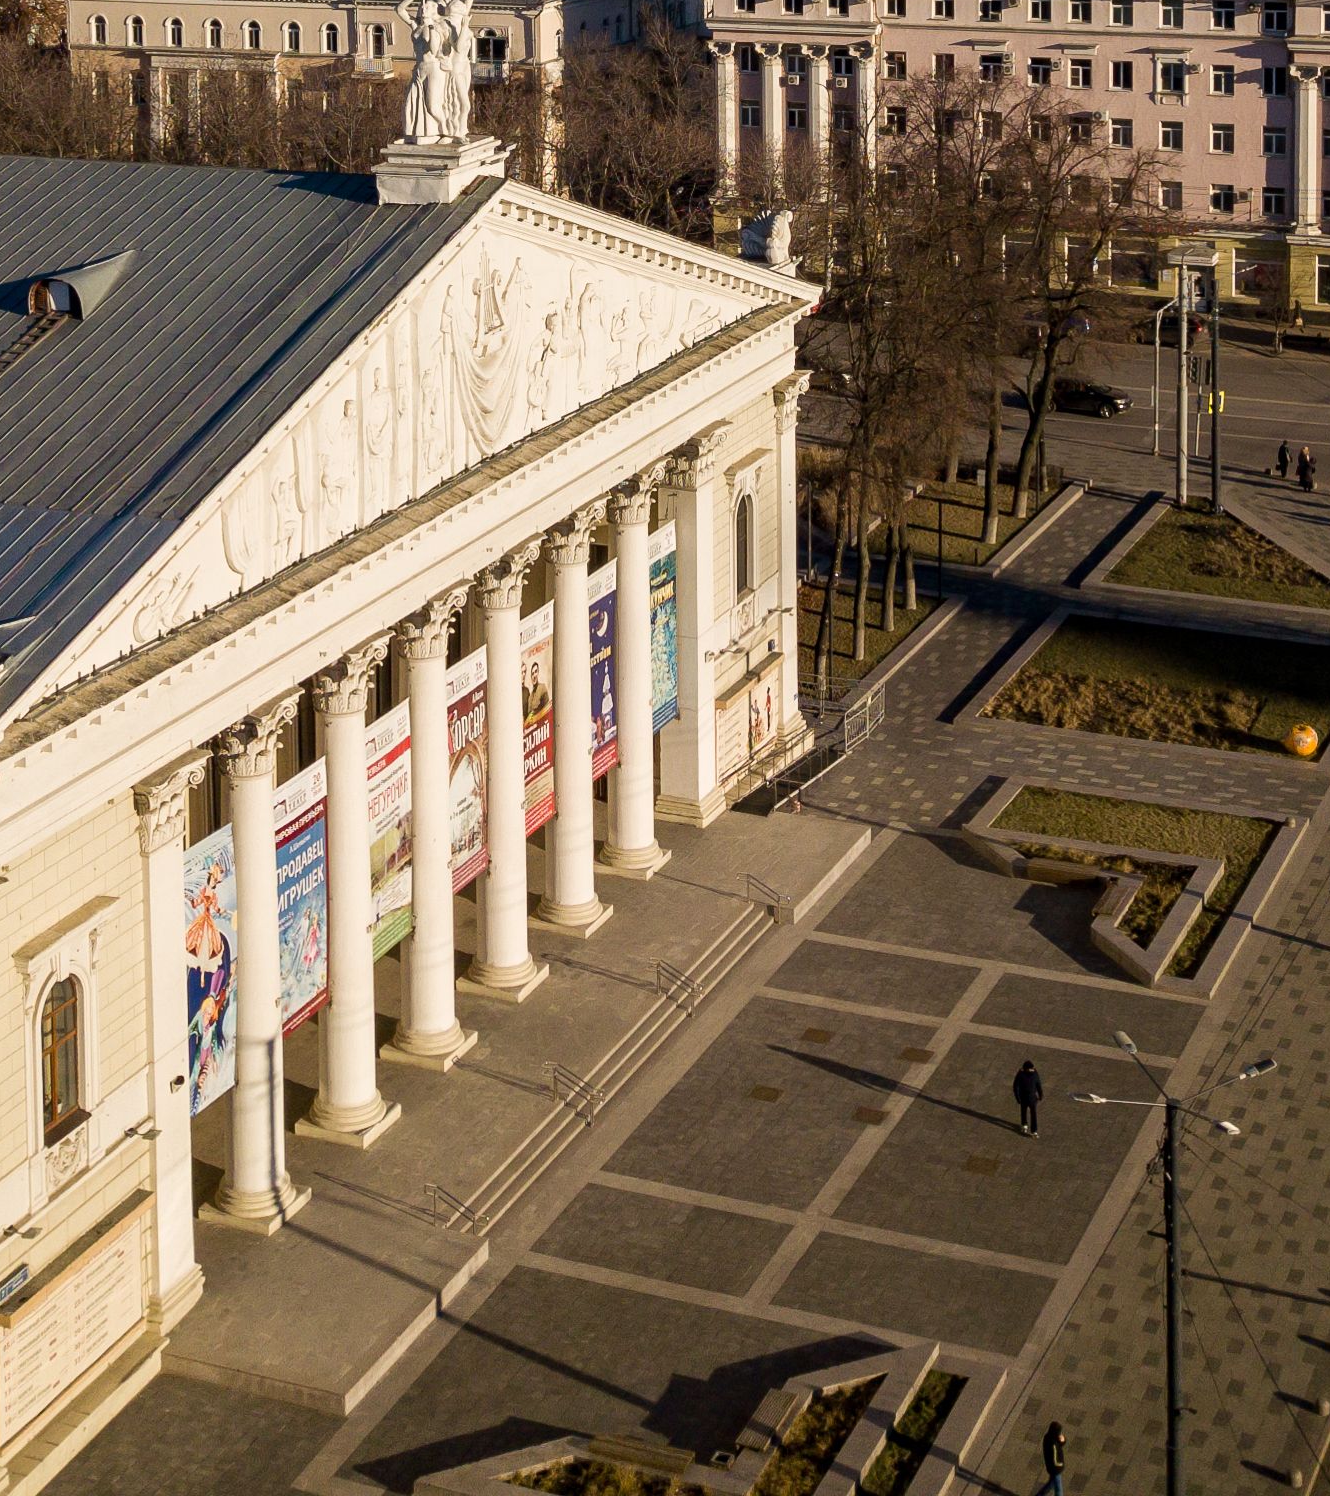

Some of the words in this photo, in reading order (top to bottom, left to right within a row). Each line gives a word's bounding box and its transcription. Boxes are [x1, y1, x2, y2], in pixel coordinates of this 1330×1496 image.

[523, 719, 549, 755] СИЛИЙ
[524, 746, 547, 775] РКИН
[368, 770, 408, 822] НЕГУРОЧКА
[276, 837, 324, 884] ПРОДАВЕЦ
[277, 863, 325, 914] ИГРУШЕК
